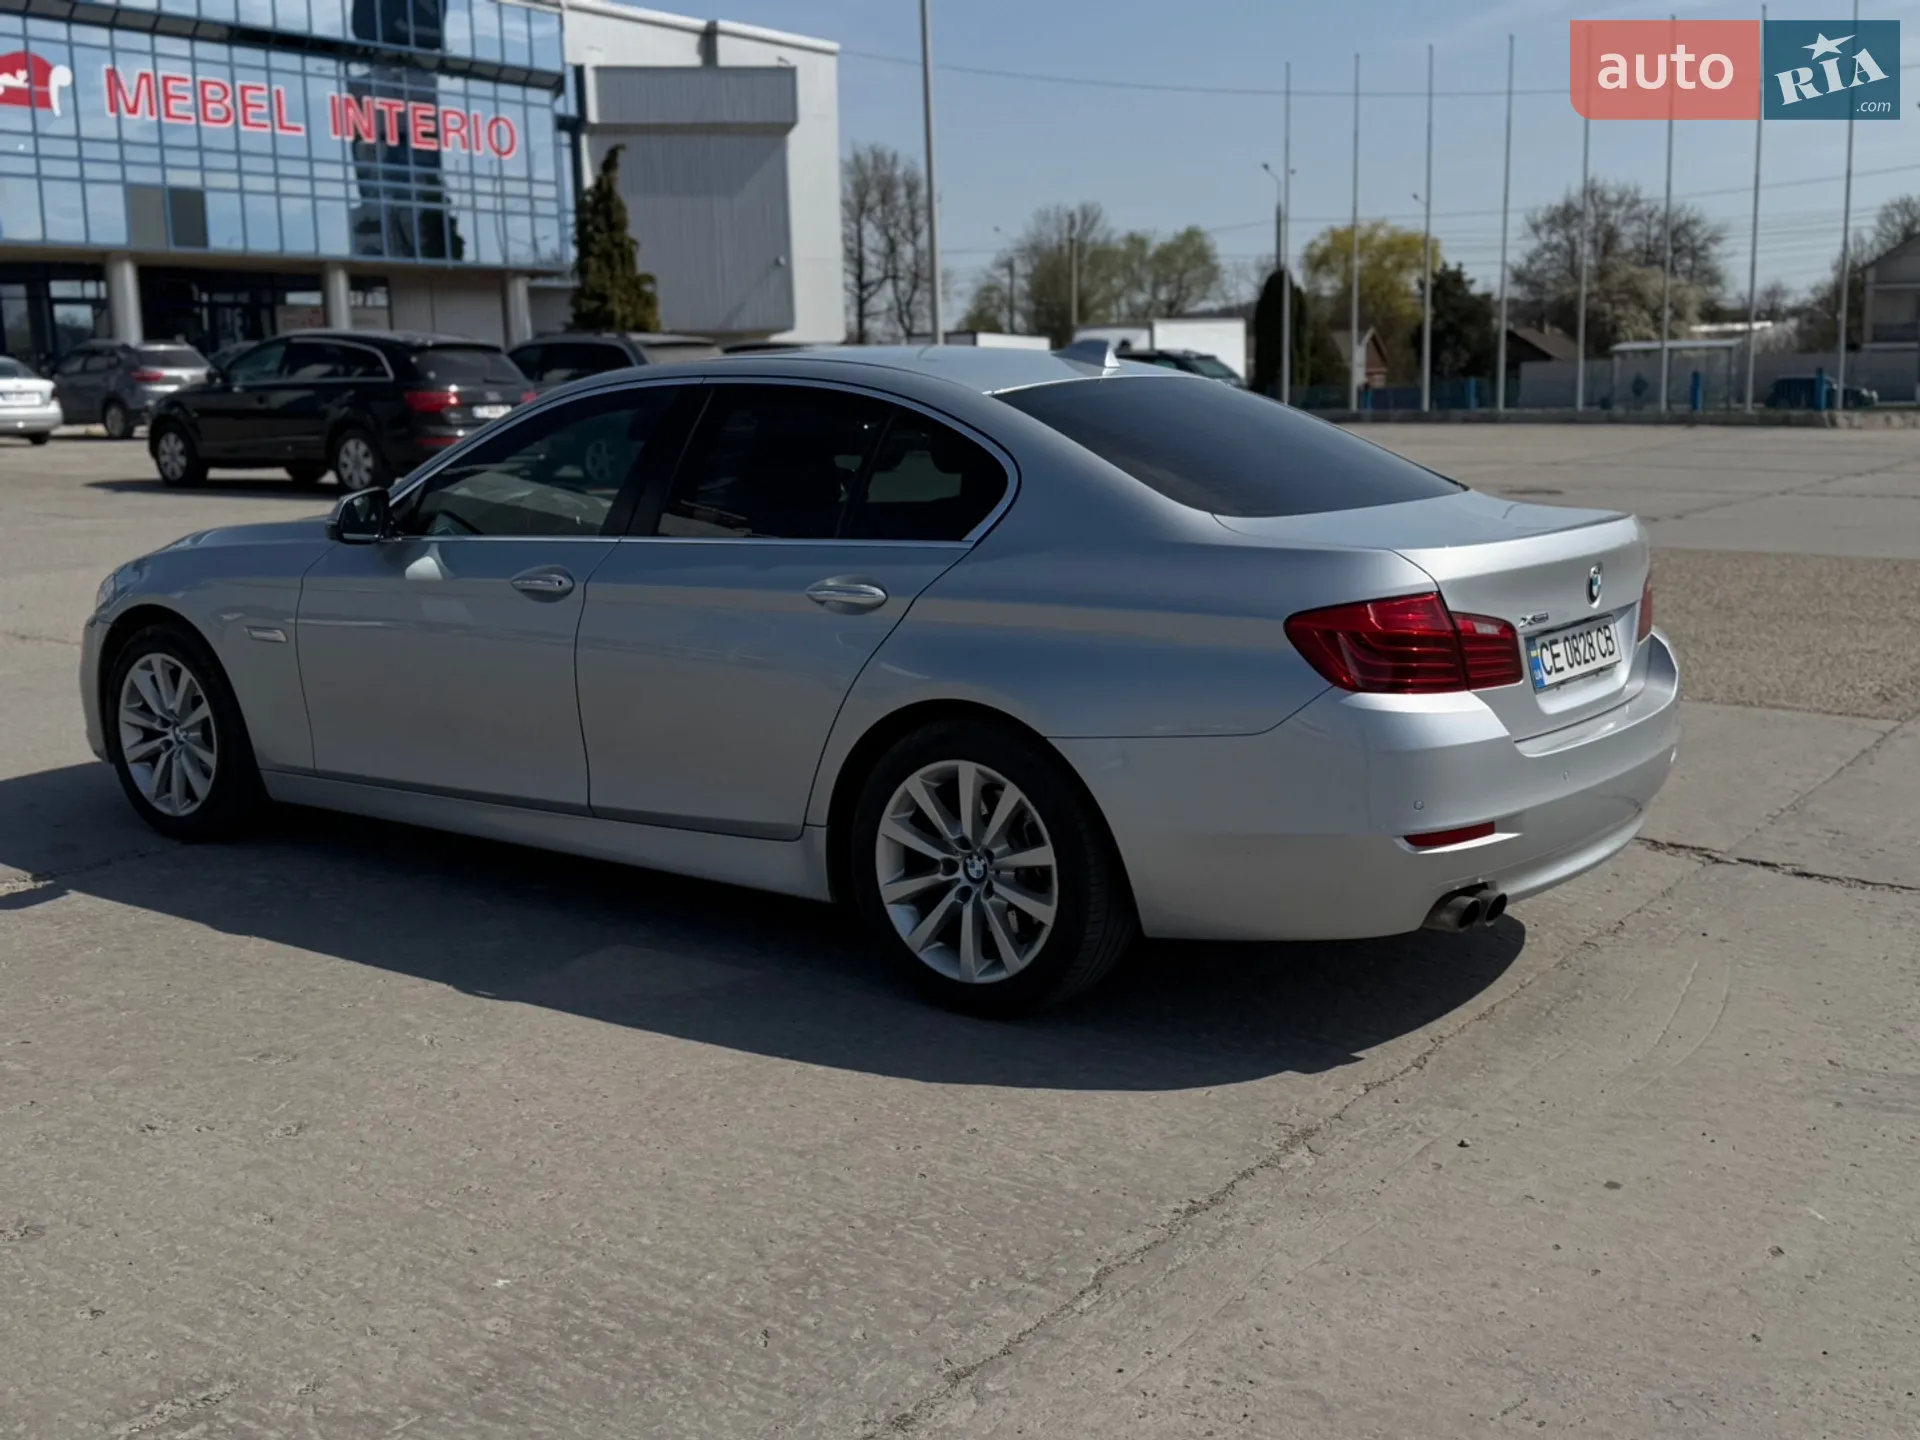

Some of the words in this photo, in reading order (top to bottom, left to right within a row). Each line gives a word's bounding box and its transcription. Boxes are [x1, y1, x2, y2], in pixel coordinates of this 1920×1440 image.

[103, 64, 305, 137] MEBEL
[328, 91, 517, 160] INTERIO
[1540, 639, 1564, 675] CE
[1564, 631, 1595, 668] 0828
[1597, 625, 1615, 657] CB
